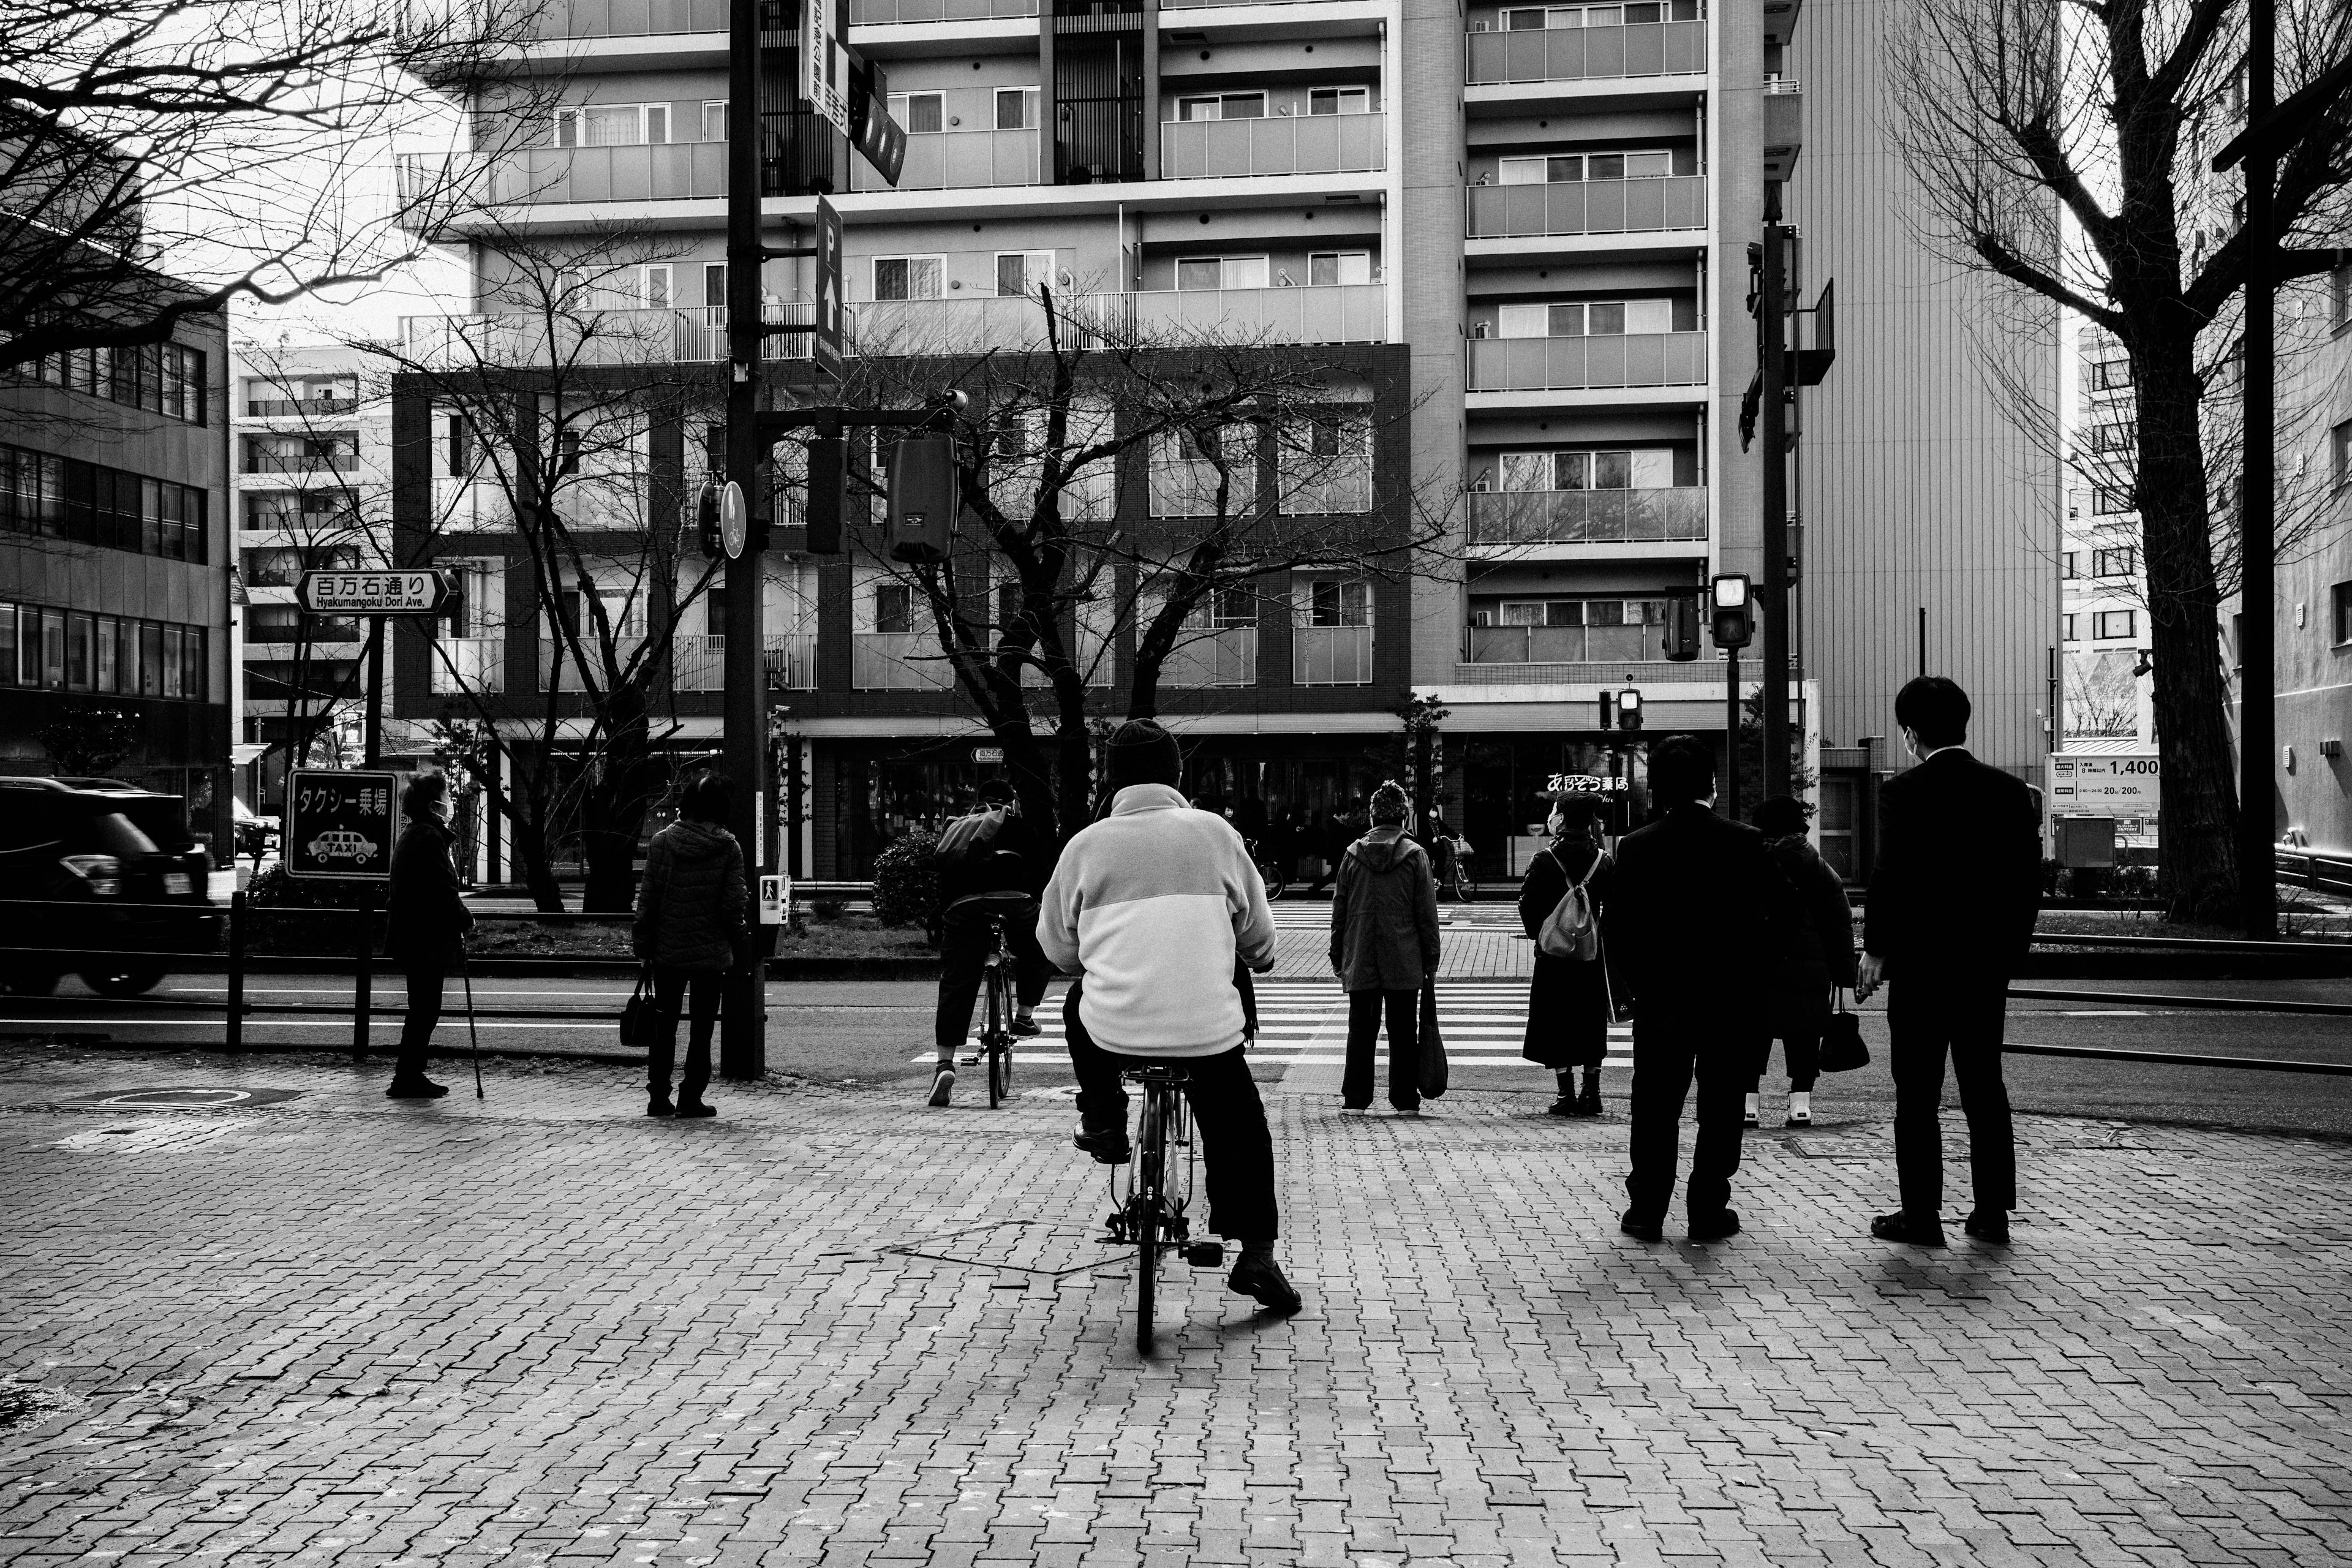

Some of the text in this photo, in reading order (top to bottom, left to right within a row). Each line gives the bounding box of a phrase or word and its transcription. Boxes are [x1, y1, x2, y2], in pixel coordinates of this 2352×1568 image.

[827, 225, 834, 263] P
[317, 576, 424, 595] 百万石通り
[317, 597, 425, 609] Hyakumangoku Dori Ave.
[2110, 761, 2158, 775] 1,400
[300, 787, 387, 816] タクシー乗場
[327, 843, 356, 853] TAXI
